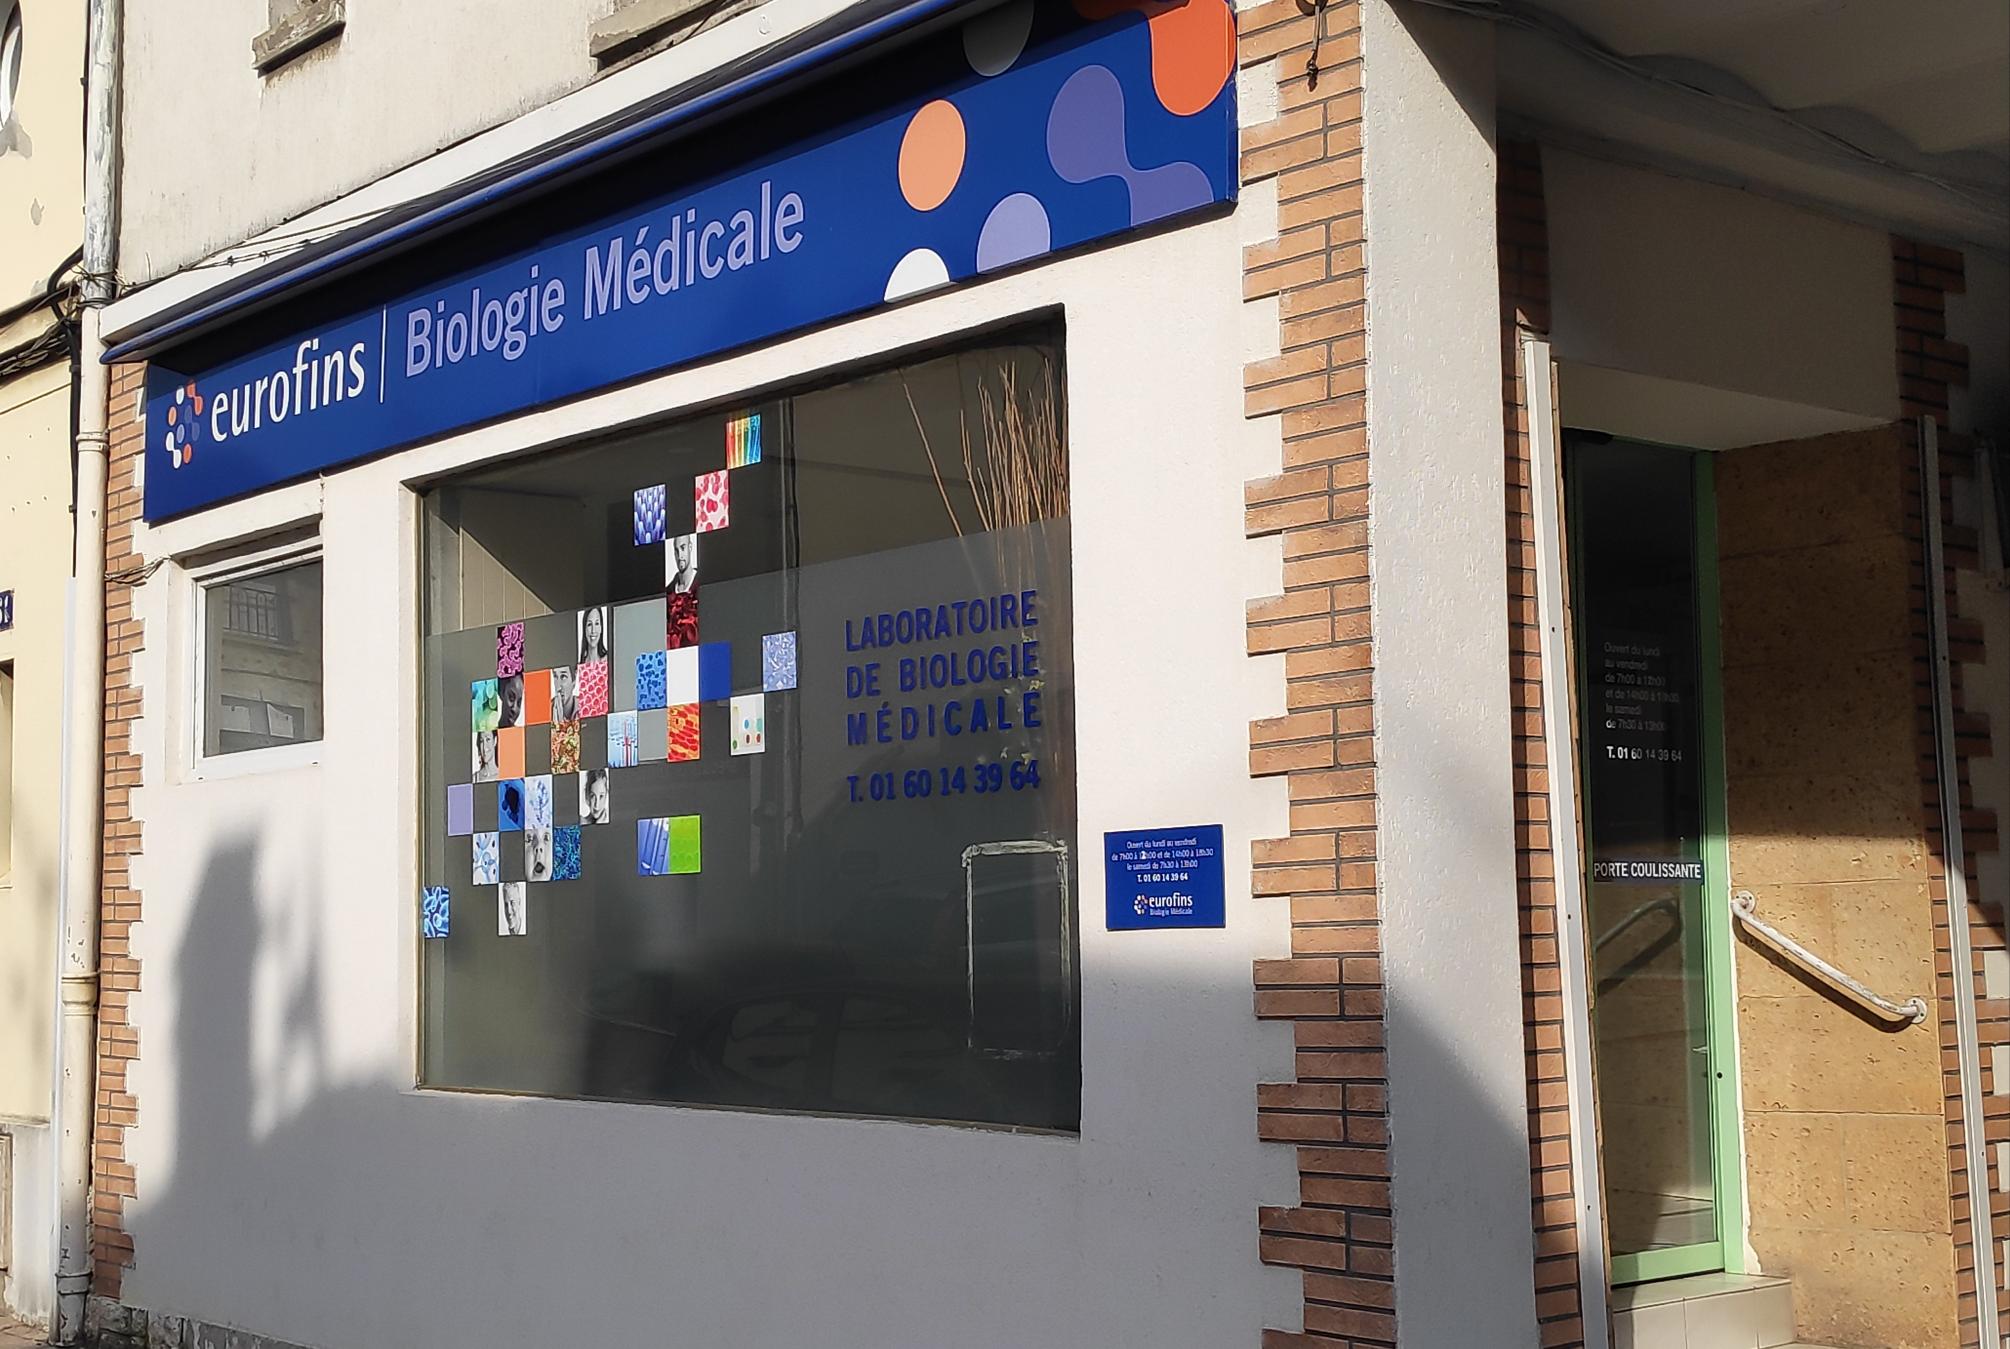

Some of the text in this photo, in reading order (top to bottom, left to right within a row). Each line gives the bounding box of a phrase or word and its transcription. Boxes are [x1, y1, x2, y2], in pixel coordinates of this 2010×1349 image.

[211, 180, 805, 443] eurofins Biologie Médicale
[845, 589, 1039, 652] LABORATOIRE
[846, 640, 1039, 699] DE BIOLOGIE
[847, 691, 1042, 746] MÉDICALE
[1606, 746, 1616, 759] T.
[1617, 746, 1629, 759] 01
[1631, 748, 1642, 760] 60
[1646, 748, 1656, 759] 14
[1658, 749, 1669, 761] 39
[847, 759, 1041, 803] T. 01 60 14 39 64
[1143, 874, 1152, 882] 01
[1162, 873, 1170, 881] 14
[1594, 862, 1702, 878] PORTE COULISSANTE
[1149, 892, 1193, 907] eurofins
